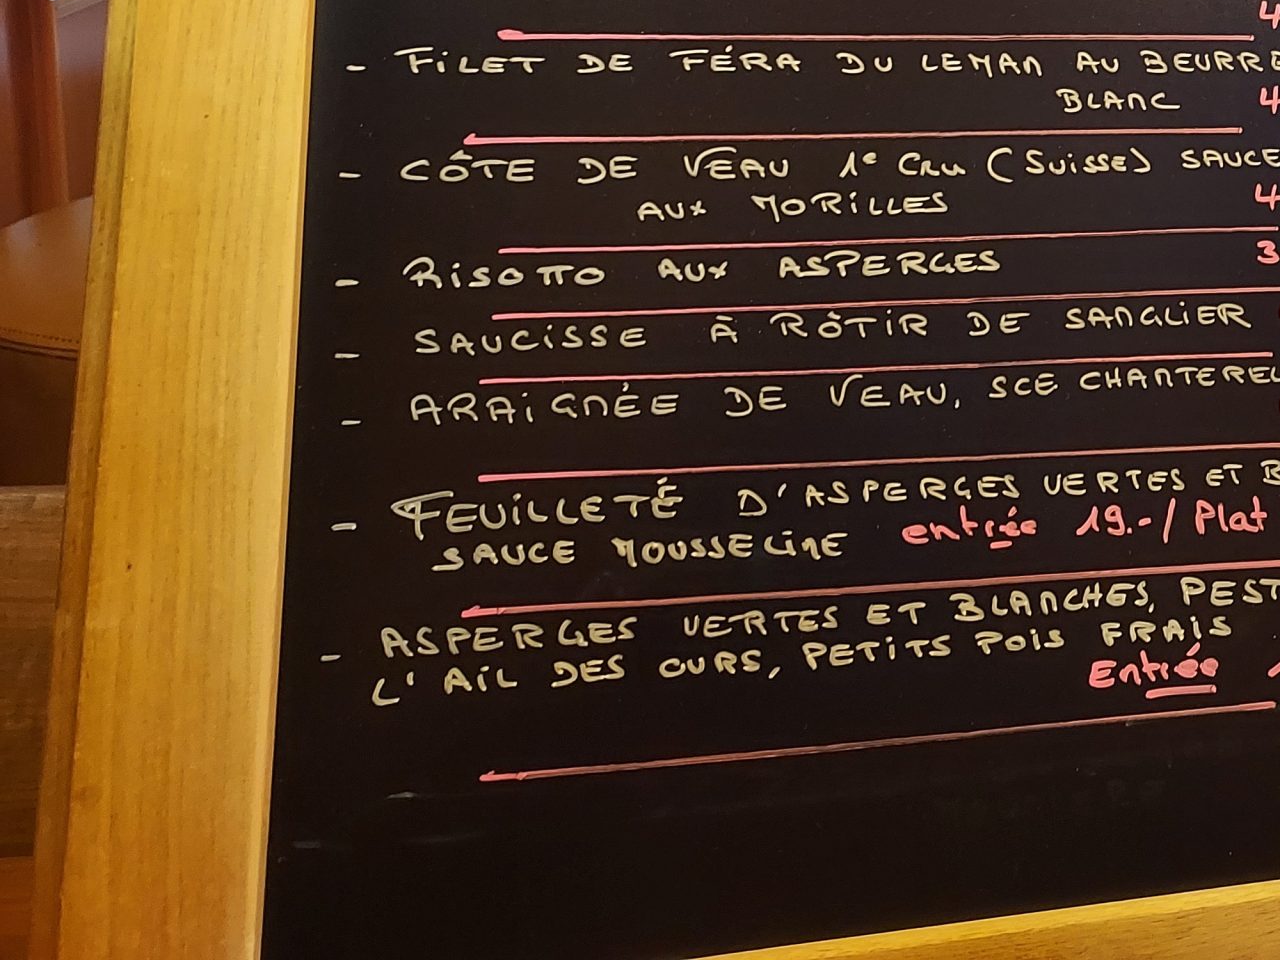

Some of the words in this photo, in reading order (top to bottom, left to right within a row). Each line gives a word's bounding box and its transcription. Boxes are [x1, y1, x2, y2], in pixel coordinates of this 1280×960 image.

[576, 52, 634, 75] DE
[668, 44, 803, 73] FÉRA
[835, 50, 894, 75] DU
[920, 52, 1044, 79] LEMAN
[1075, 53, 1121, 74] AU
[1055, 88, 1182, 113] BLANC
[399, 149, 537, 183] CÔTE
[576, 155, 640, 186] DE
[683, 145, 791, 180] VEAU
[778, 249, 1003, 280] ASPERGES
[966, 310, 1032, 339] DE
[723, 385, 788, 418] DE
[829, 373, 963, 411] VEAU,
[987, 372, 1059, 400] SCE
[1042, 467, 1187, 497] VERTES
[1204, 462, 1245, 488] ET
[430, 538, 577, 573] SAUCE
[900, 503, 1038, 545] entrée
[1194, 495, 1269, 535] Plat
[380, 616, 640, 659] ASPERGES
[682, 605, 840, 638] VERTES
[864, 600, 928, 626] ET
[948, 579, 1156, 624] BLANCHES,
[550, 652, 627, 689] DES
[657, 648, 782, 681] OURS,
[1087, 641, 1221, 690] Entrée
